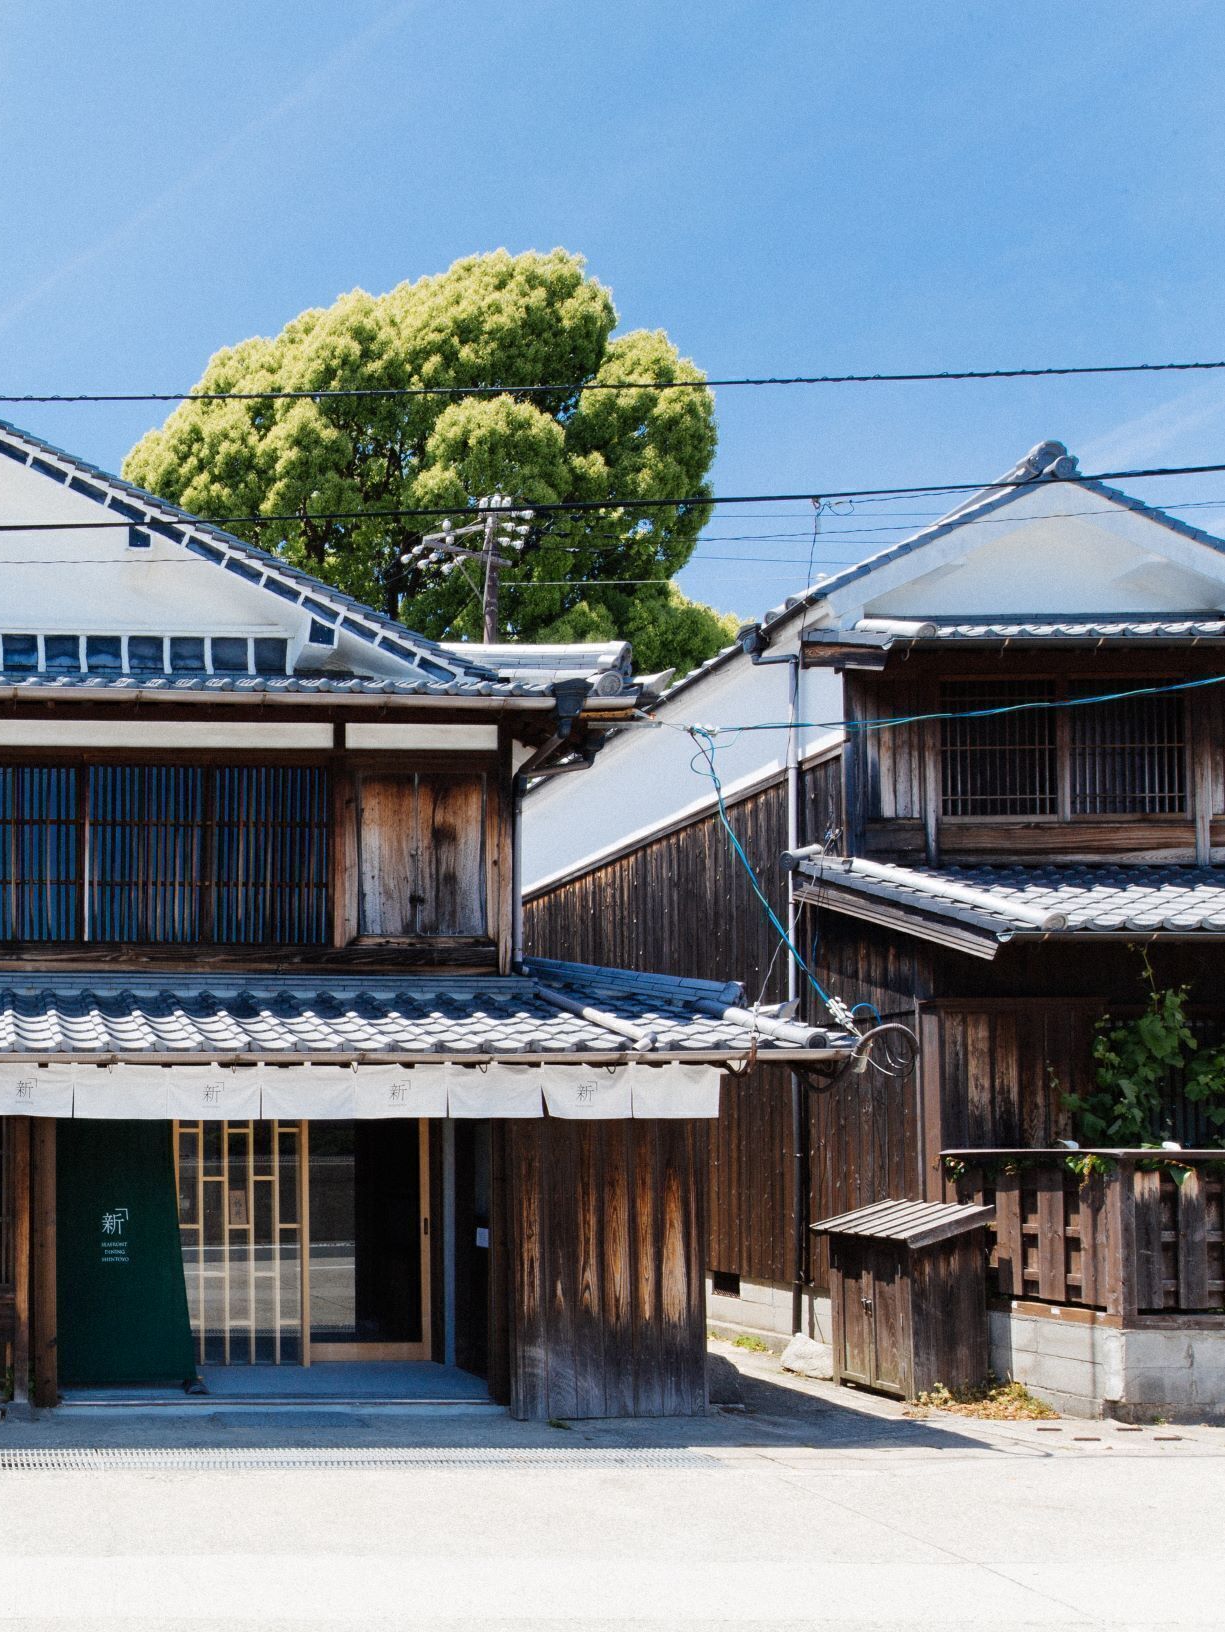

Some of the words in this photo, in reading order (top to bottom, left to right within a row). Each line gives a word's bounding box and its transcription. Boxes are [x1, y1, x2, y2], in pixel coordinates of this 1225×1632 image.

[16, 1080, 34, 1099] 新
[202, 1084, 221, 1103] 新
[389, 1083, 408, 1102] 新
[576, 1084, 595, 1103] 新
[101, 1212, 125, 1235] 新
